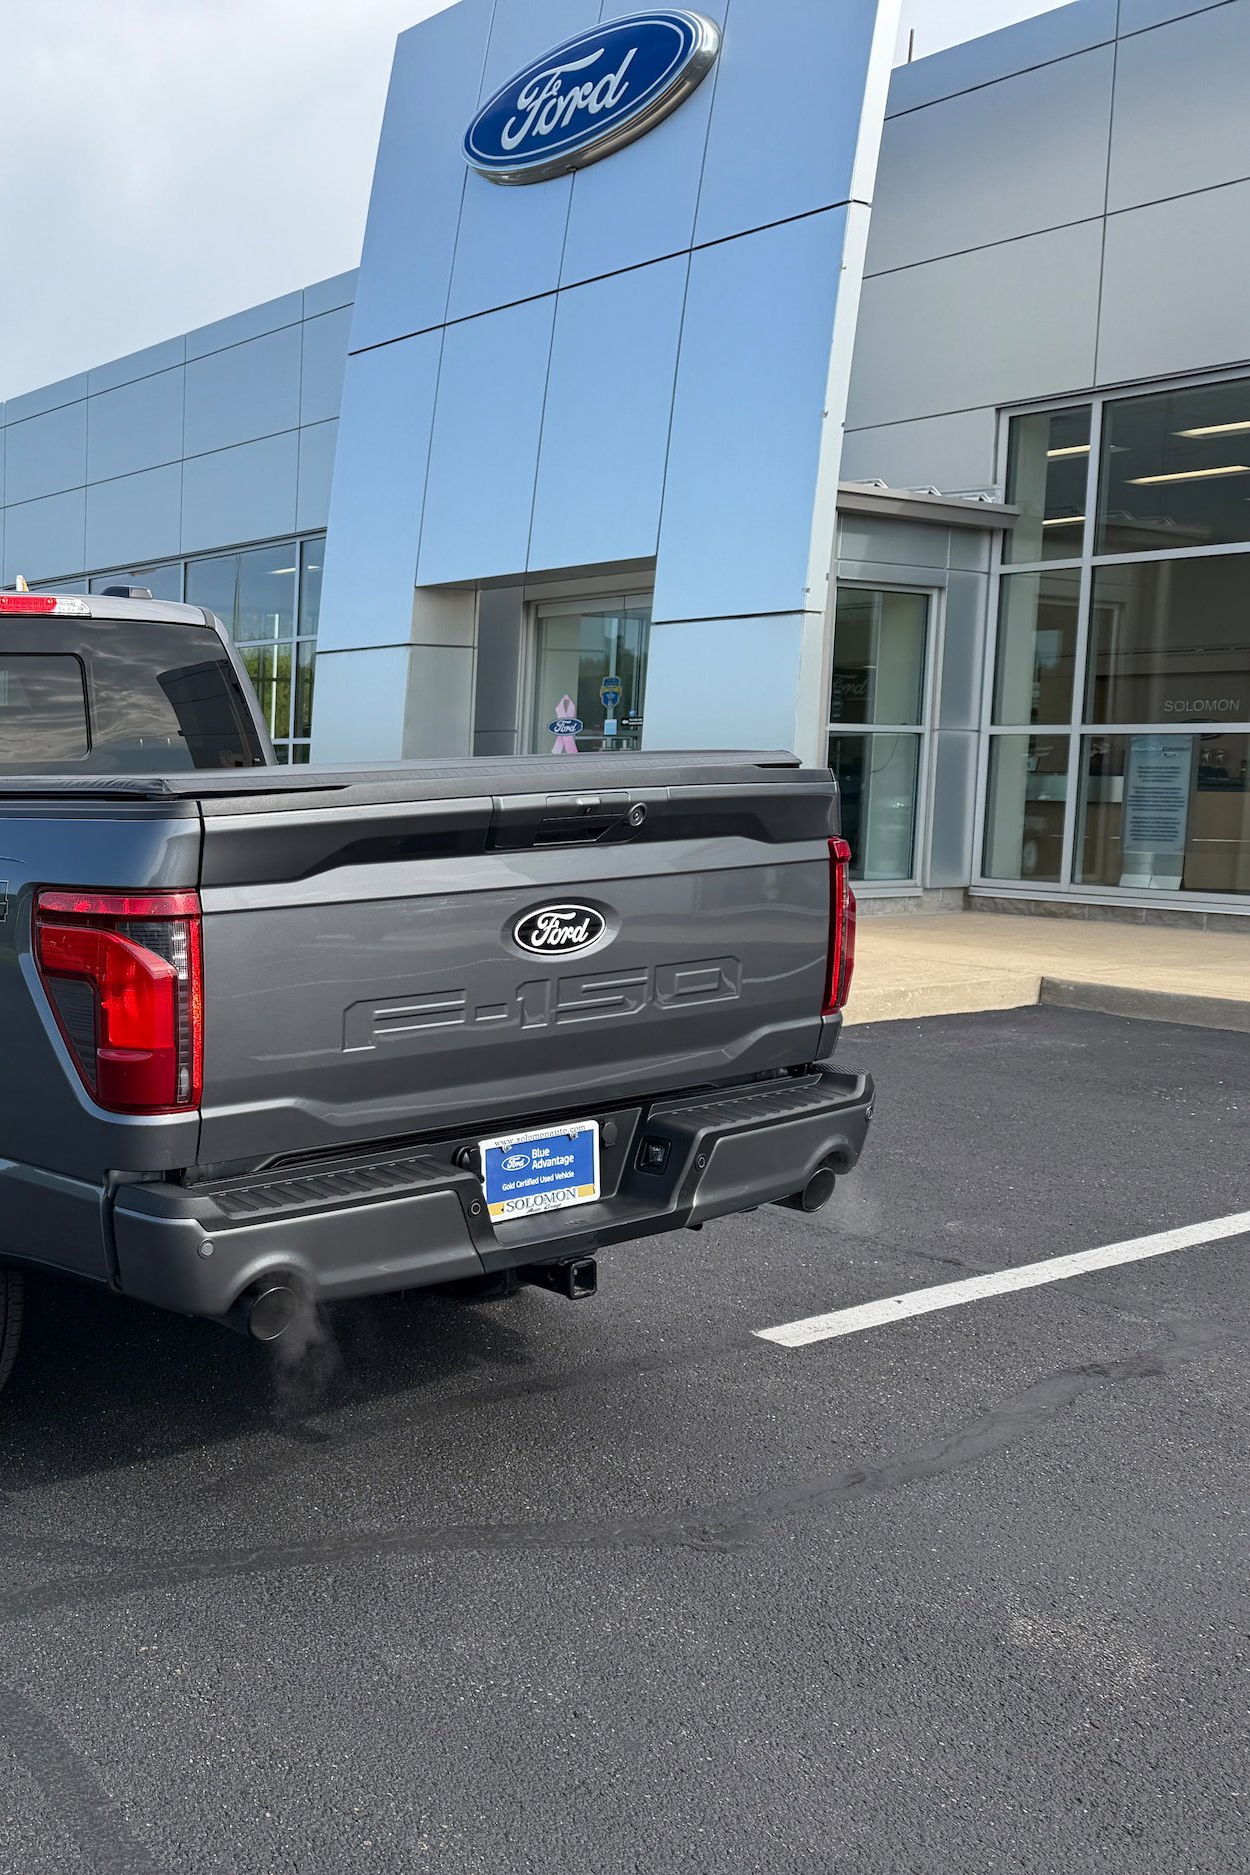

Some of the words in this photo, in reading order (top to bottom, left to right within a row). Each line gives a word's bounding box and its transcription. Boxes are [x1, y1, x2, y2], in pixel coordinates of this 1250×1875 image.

[501, 47, 638, 150] Ford
[1164, 699, 1240, 712] SOLOMON
[554, 720, 577, 733] Ford
[530, 911, 590, 948] Ford
[342, 956, 742, 1053] F-150
[494, 1125, 586, 1146] www.solomonauto.com
[507, 1156, 525, 1169] Ford
[531, 1148, 550, 1159] Blue
[531, 1154, 575, 1170] Advantage
[502, 1182, 516, 1191] Gold
[516, 1177, 539, 1188] Certified
[539, 1174, 555, 1184] Used
[555, 1170, 575, 1181] Vehicle
[506, 1187, 577, 1213] SOLOMON
